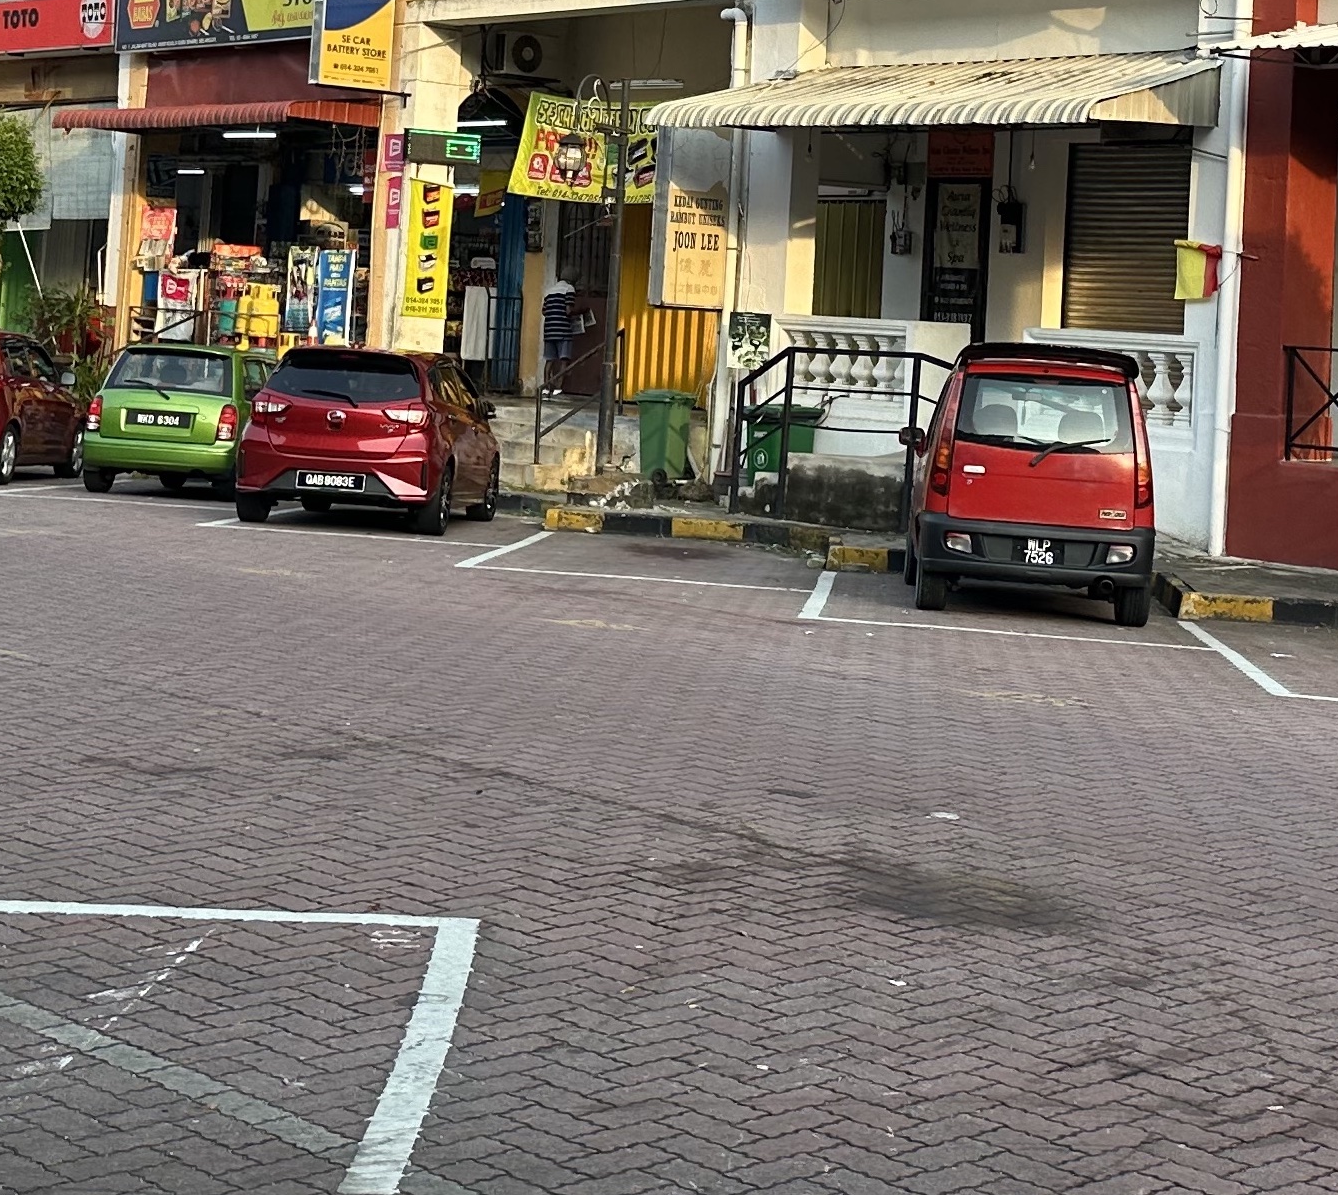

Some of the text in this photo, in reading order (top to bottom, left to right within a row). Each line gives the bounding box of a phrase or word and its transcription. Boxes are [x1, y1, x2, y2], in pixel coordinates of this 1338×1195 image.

[3, 8, 39, 30] TOTO
[81, 2, 107, 23] TOTO
[341, 34, 371, 46] SE CAR
[327, 43, 386, 59] BATTERY STORE
[674, 195, 723, 211] KEDAI GUNTING
[670, 211, 696, 225] RAMBUT
[939, 220, 977, 233] Wellness
[673, 230, 719, 252] JOON LEE
[947, 251, 965, 264] Spa
[1027, 538, 1051, 552] WLP
[1024, 550, 1054, 564] 7526
